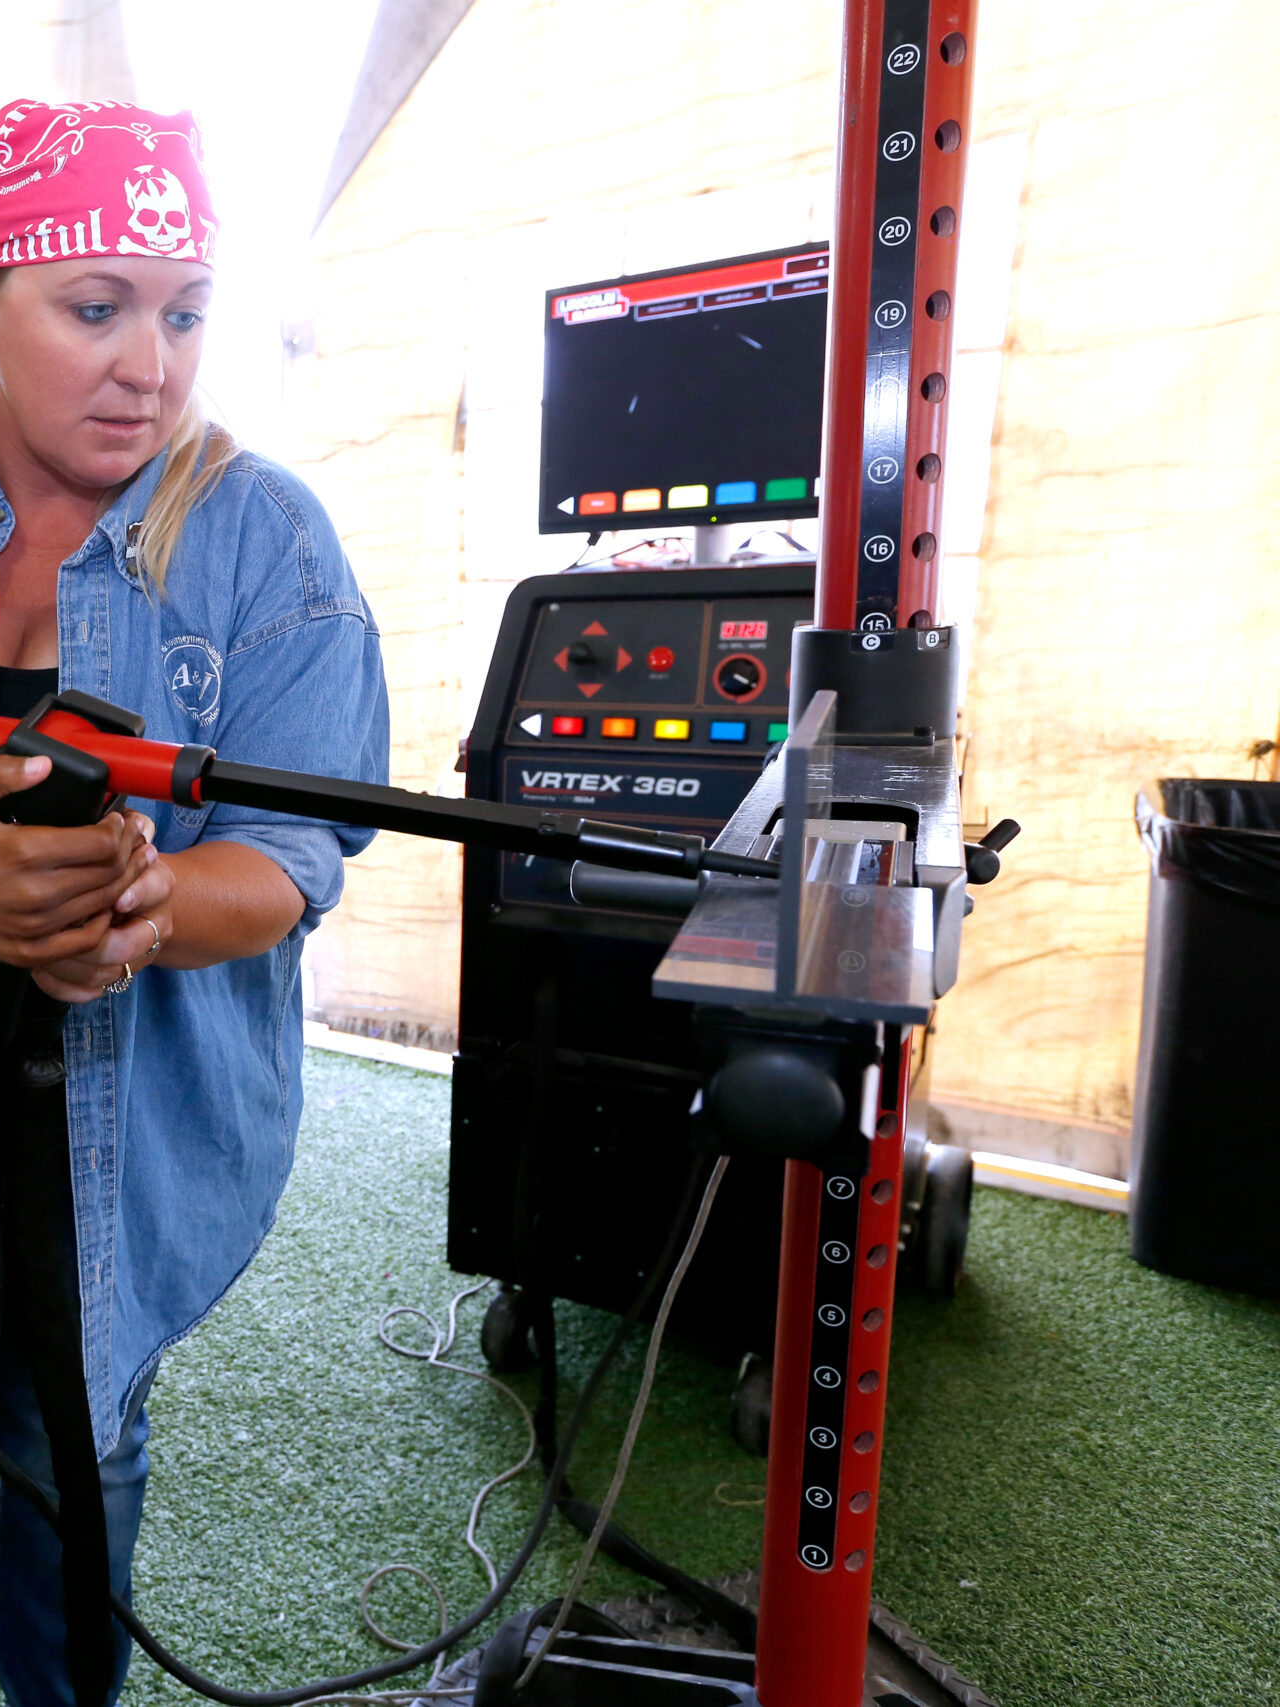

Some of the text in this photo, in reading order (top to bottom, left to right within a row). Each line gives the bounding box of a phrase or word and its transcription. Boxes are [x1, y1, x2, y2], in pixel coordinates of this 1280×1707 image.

[893, 51, 915, 68] 22
[889, 138, 908, 154] 21
[884, 224, 905, 239] 20
[881, 307, 900, 322] 19
[874, 464, 892, 477] 17
[870, 543, 889, 556] 16
[866, 620, 884, 631] 15
[521, 770, 701, 797] VRTEX 360
[836, 1182, 846, 1193] 7
[831, 1247, 841, 1257] 6
[827, 1311, 836, 1321] 5
[822, 1372, 832, 1382] 4
[818, 1433, 828, 1443] 3
[814, 1492, 824, 1503] 2
[810, 1550, 817, 1560] 1
